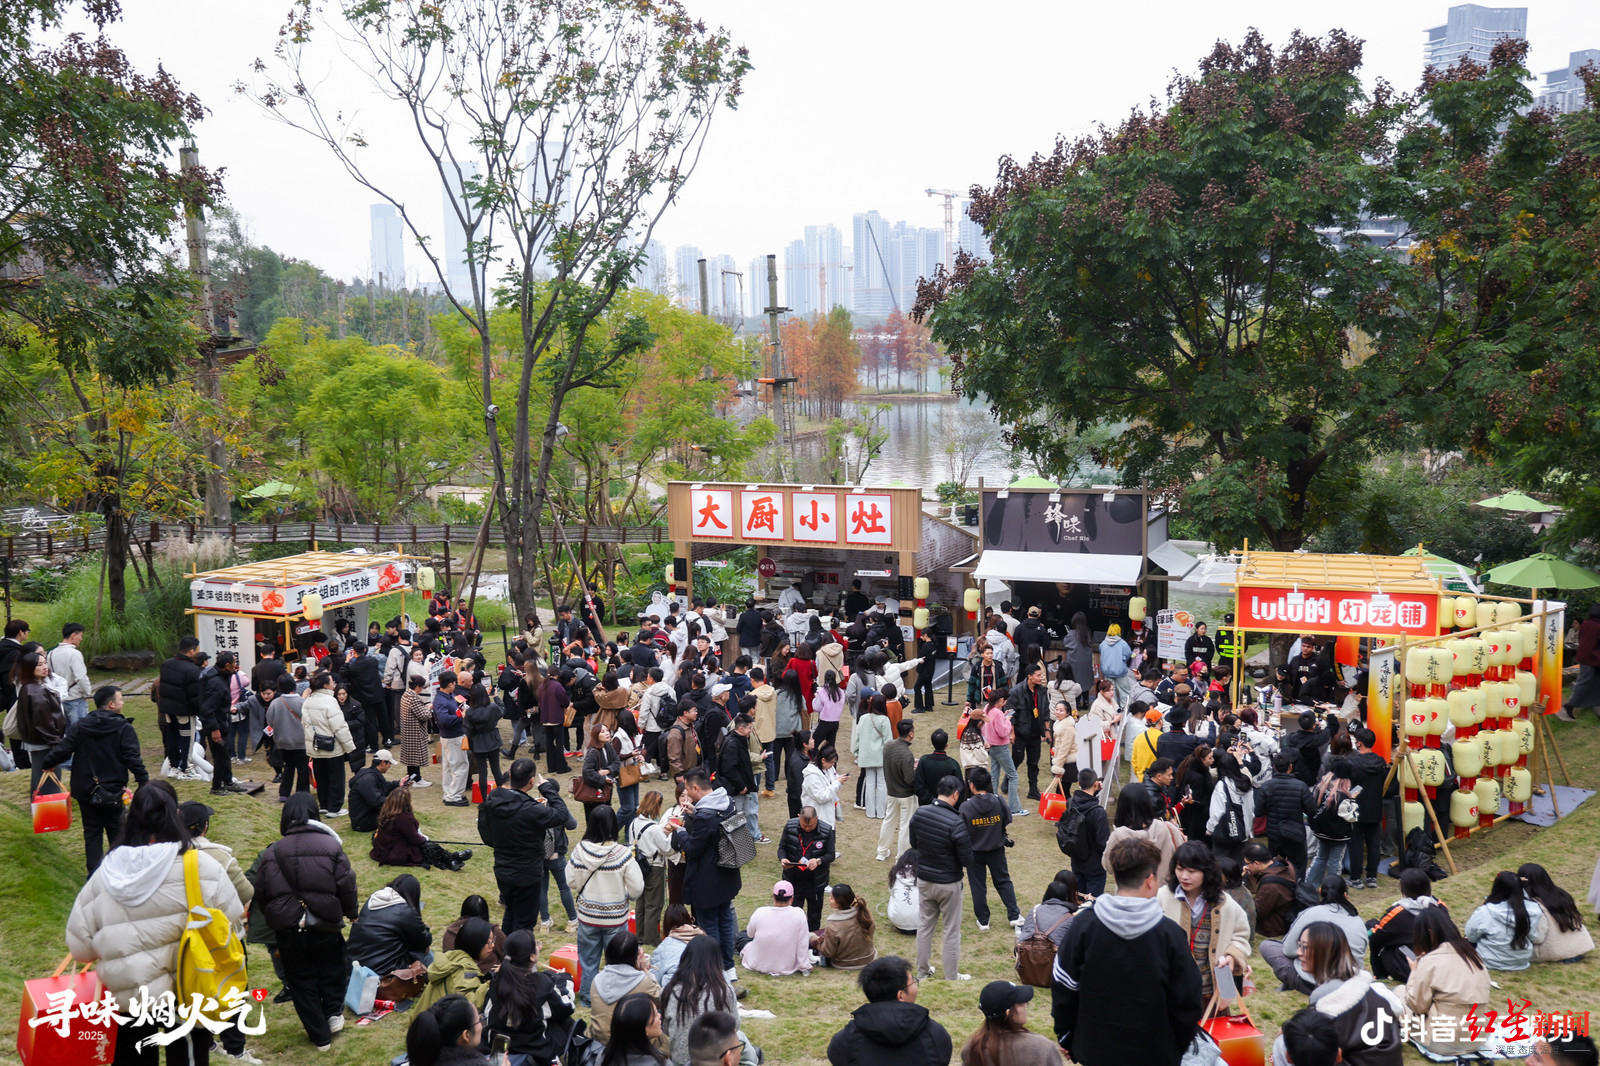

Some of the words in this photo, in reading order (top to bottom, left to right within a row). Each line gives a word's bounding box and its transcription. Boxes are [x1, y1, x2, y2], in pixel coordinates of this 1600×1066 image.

[697, 494, 886, 535] 大厨小灶
[196, 589, 260, 604] 亚萍姐的馄饨摊
